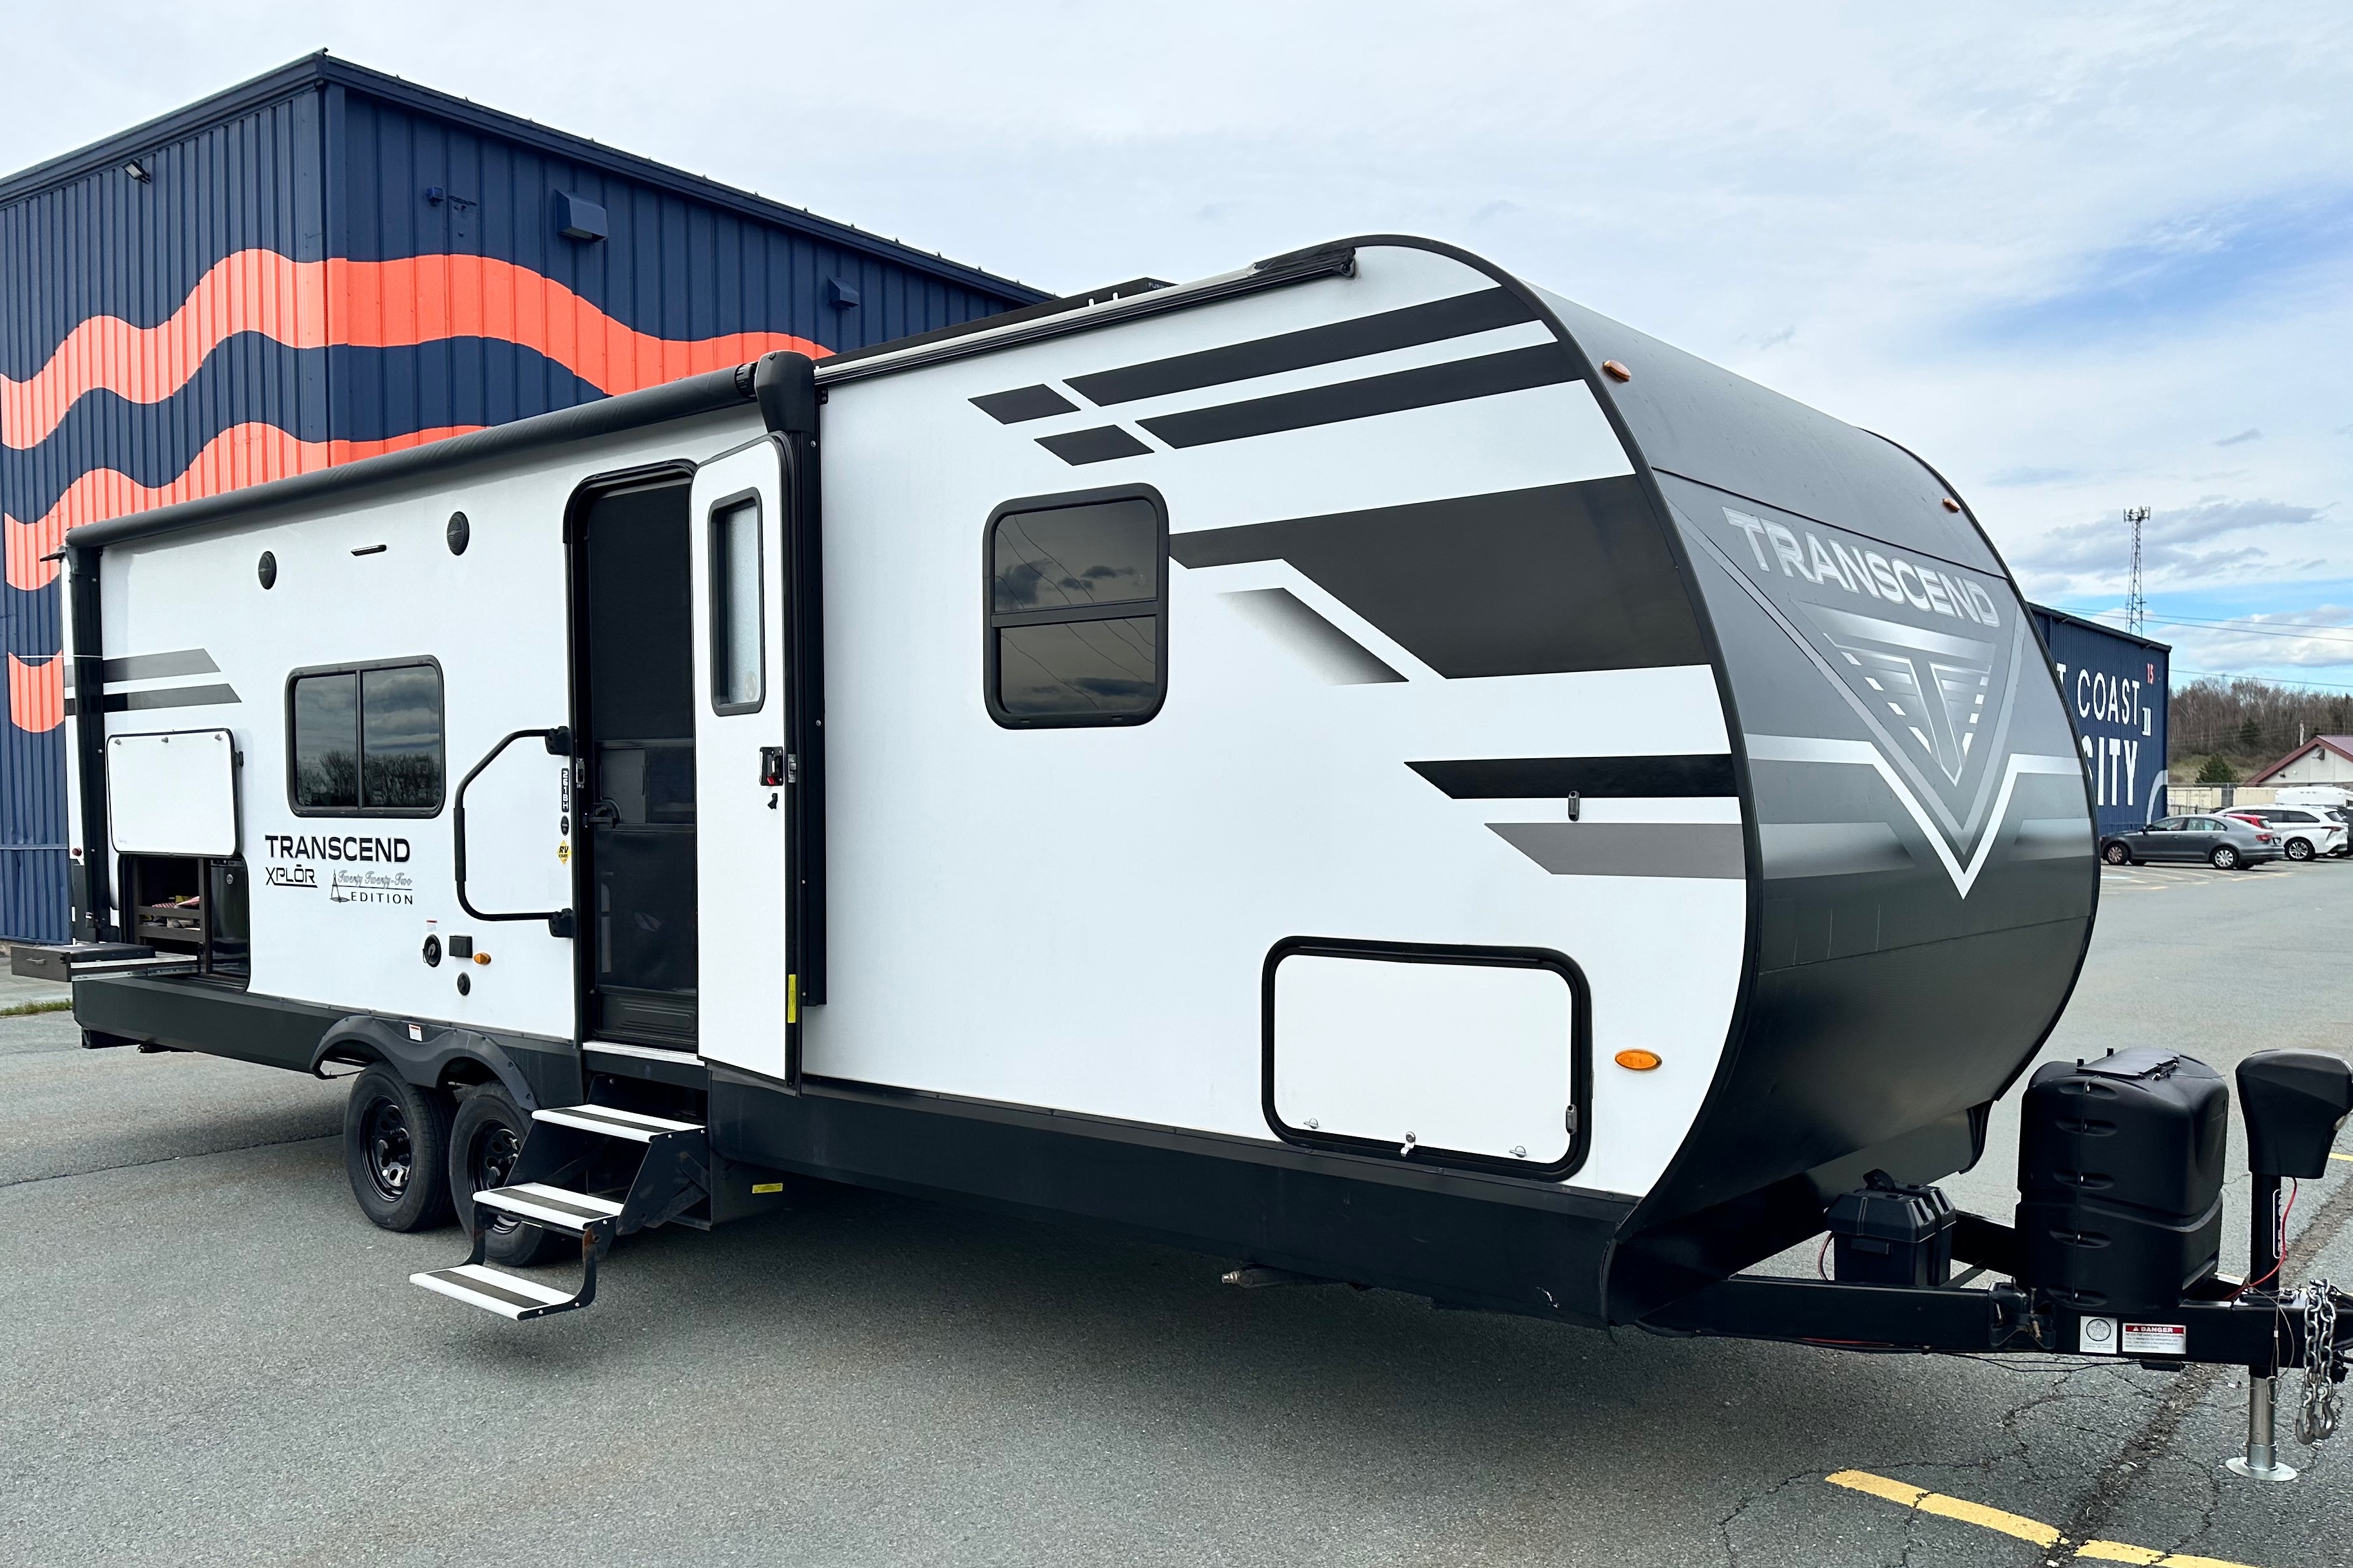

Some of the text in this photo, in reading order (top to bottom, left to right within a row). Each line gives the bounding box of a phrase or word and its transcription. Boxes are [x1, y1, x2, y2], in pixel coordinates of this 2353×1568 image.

[1722, 506, 2000, 627] TRANSCEND
[2078, 669, 2140, 725] COAST
[265, 835, 410, 863] TRANSCEND
[351, 892, 413, 905] EDITION
